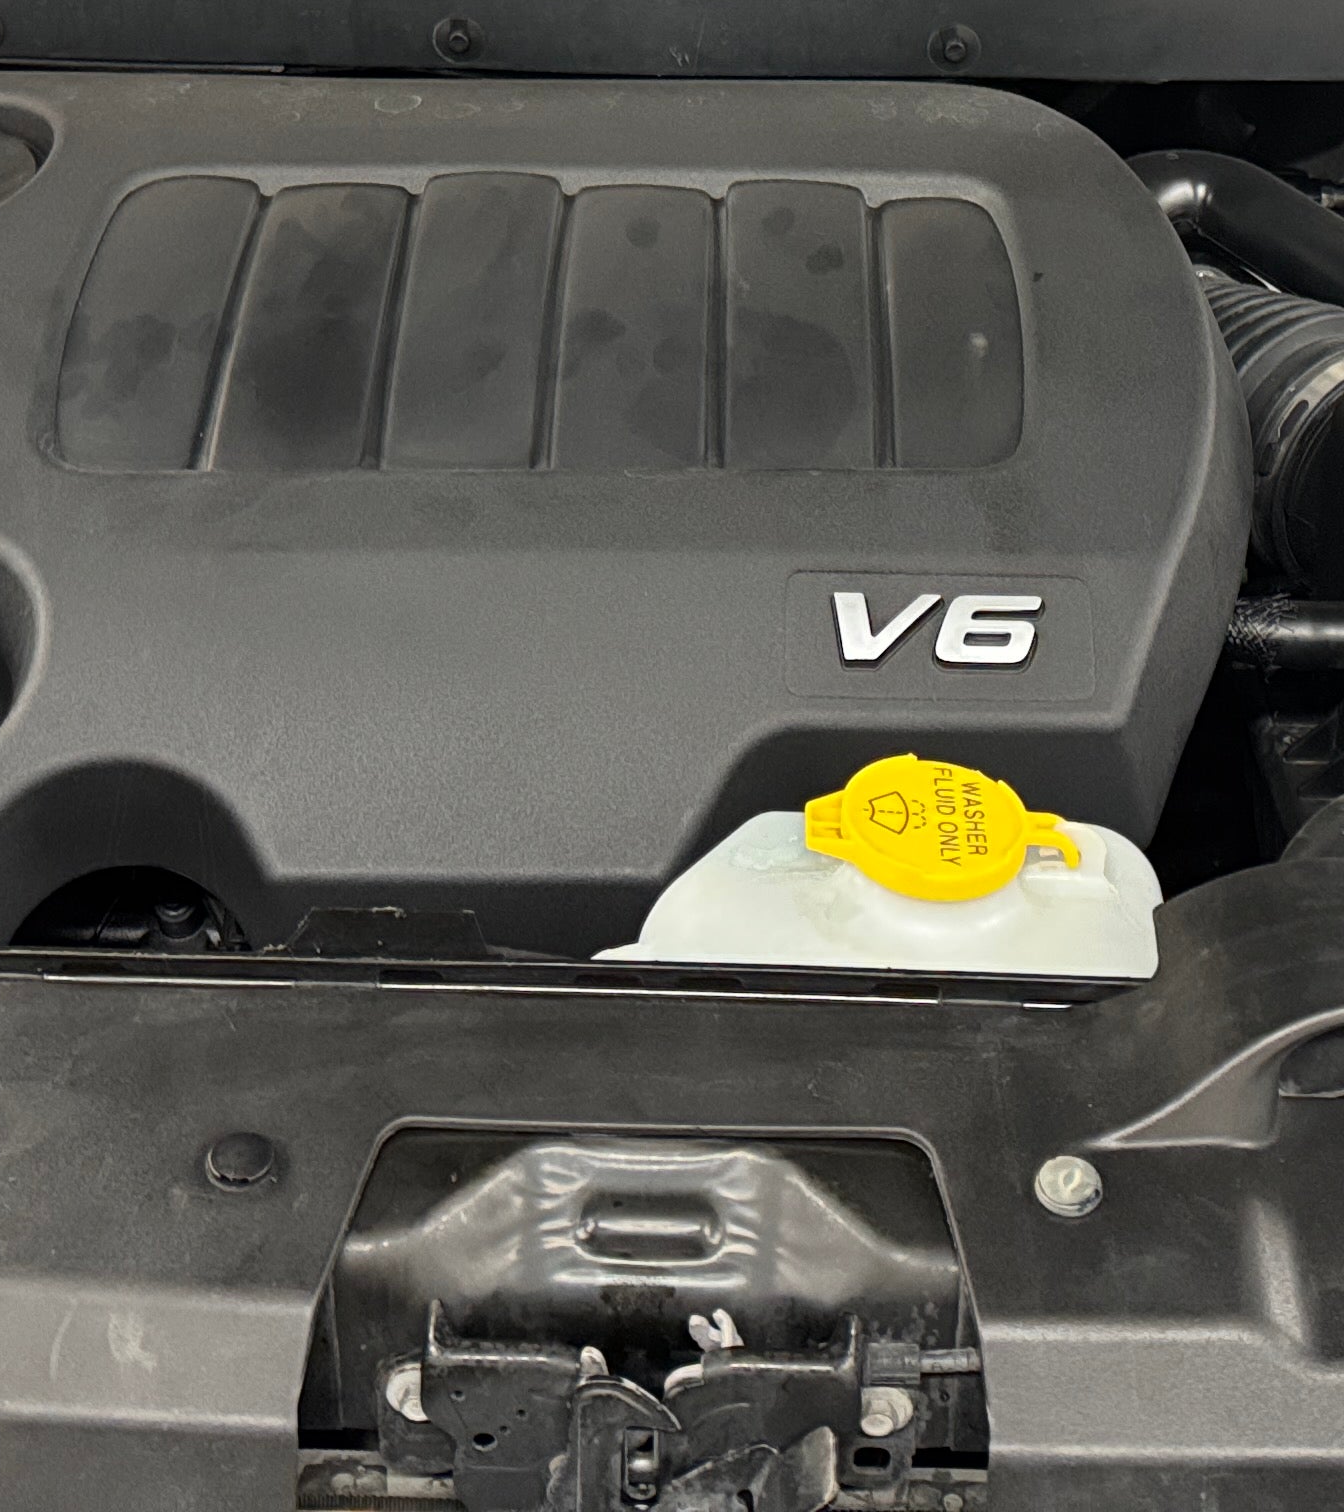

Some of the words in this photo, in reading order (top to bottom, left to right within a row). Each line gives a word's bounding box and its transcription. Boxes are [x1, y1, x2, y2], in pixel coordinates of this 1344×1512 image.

[832, 591, 1044, 668] V6
[933, 766, 956, 816] FLUID
[960, 782, 988, 855] WASHER
[937, 821, 962, 867] ONLY
